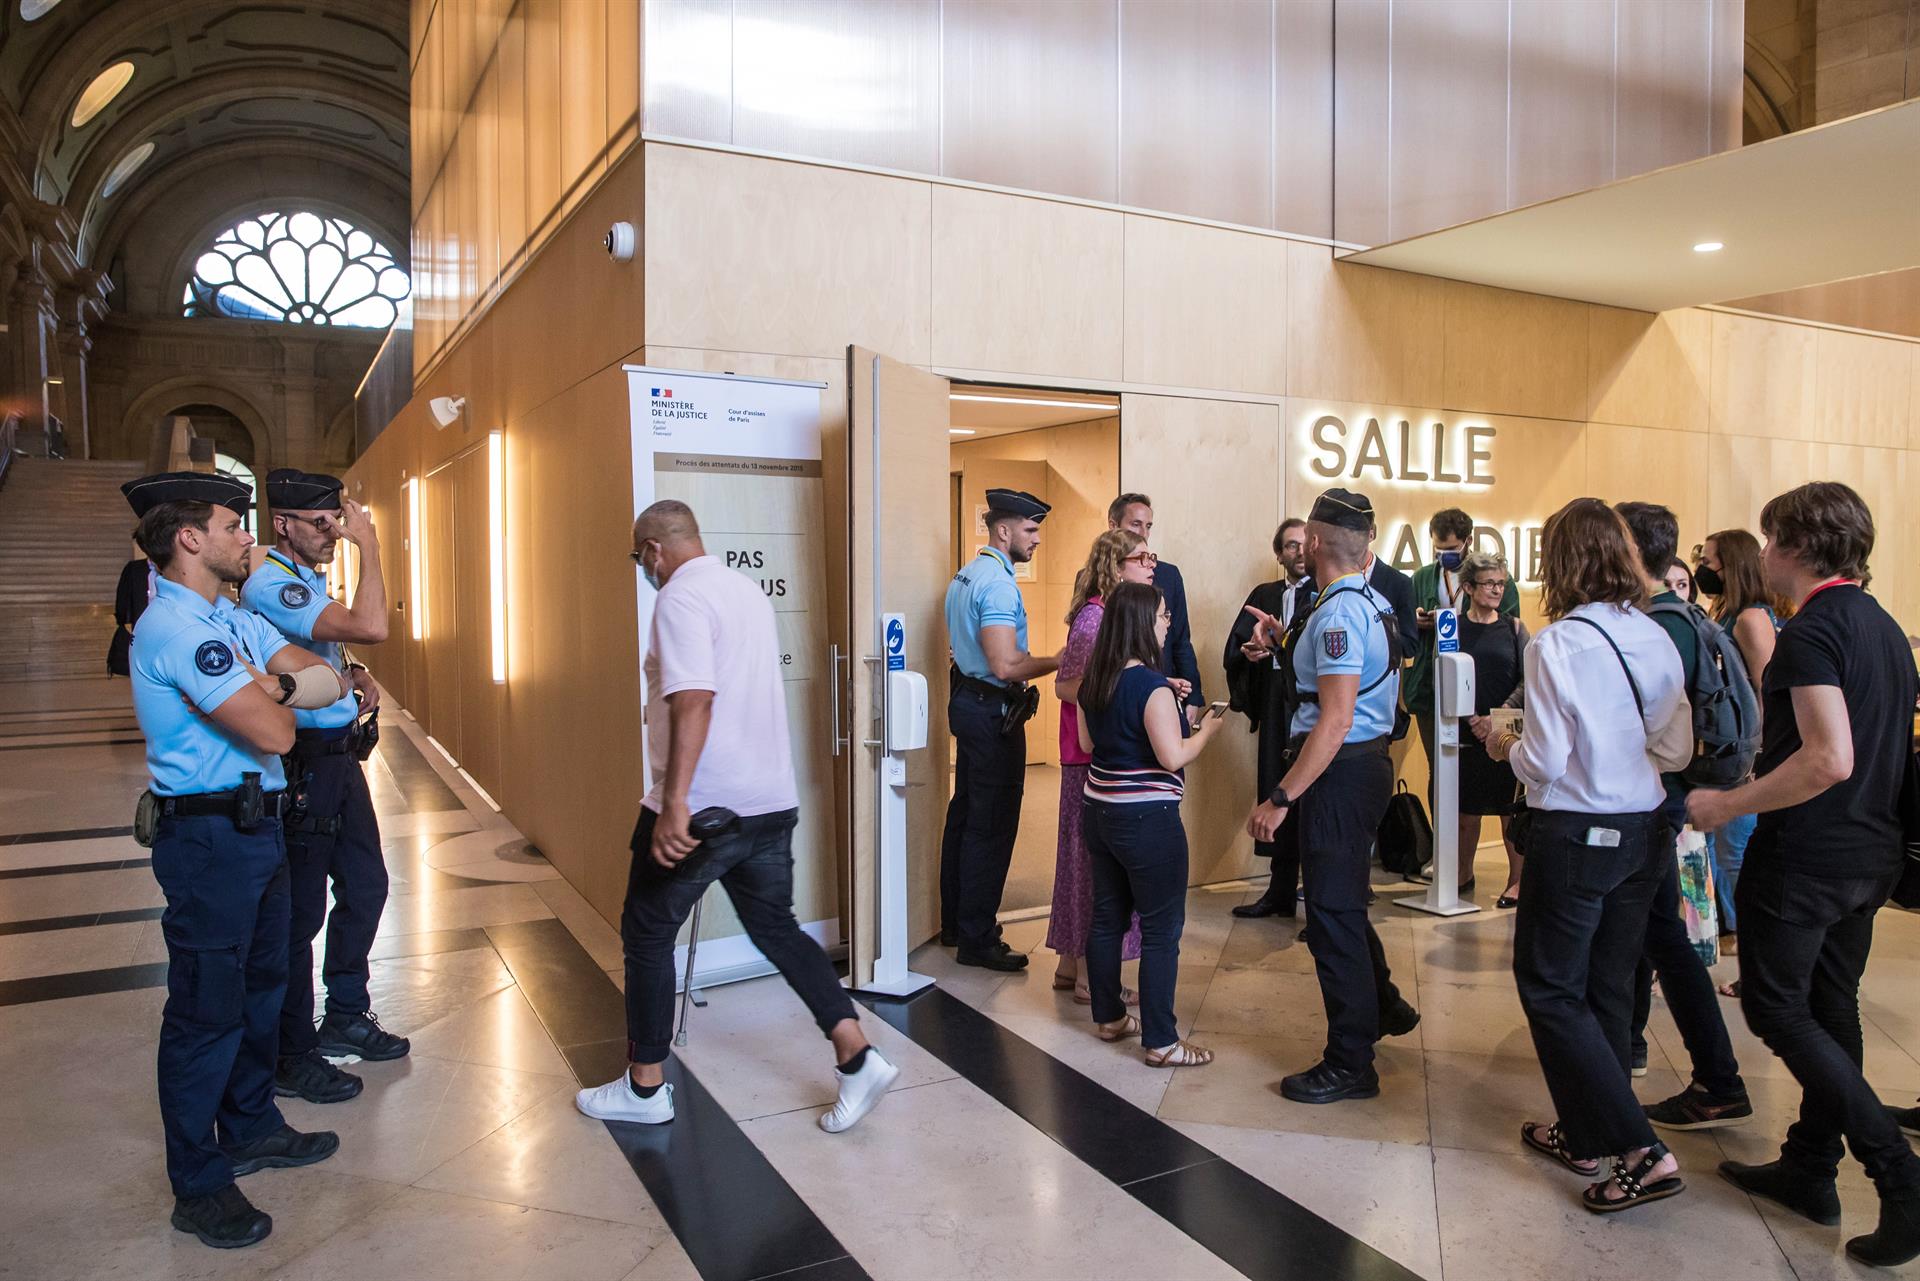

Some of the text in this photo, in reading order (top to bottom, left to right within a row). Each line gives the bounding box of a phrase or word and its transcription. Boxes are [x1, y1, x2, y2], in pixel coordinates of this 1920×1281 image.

[651, 400, 694, 410] MINISTÈRE
[651, 409, 662, 417] DE
[676, 411, 708, 420] JUSTICE
[1310, 415, 1497, 485] SALLE
[675, 459, 697, 467] Procès
[712, 461, 740, 469] attentats
[741, 462, 750, 470] du
[759, 463, 789, 471] novembre
[726, 550, 764, 569] PAS
